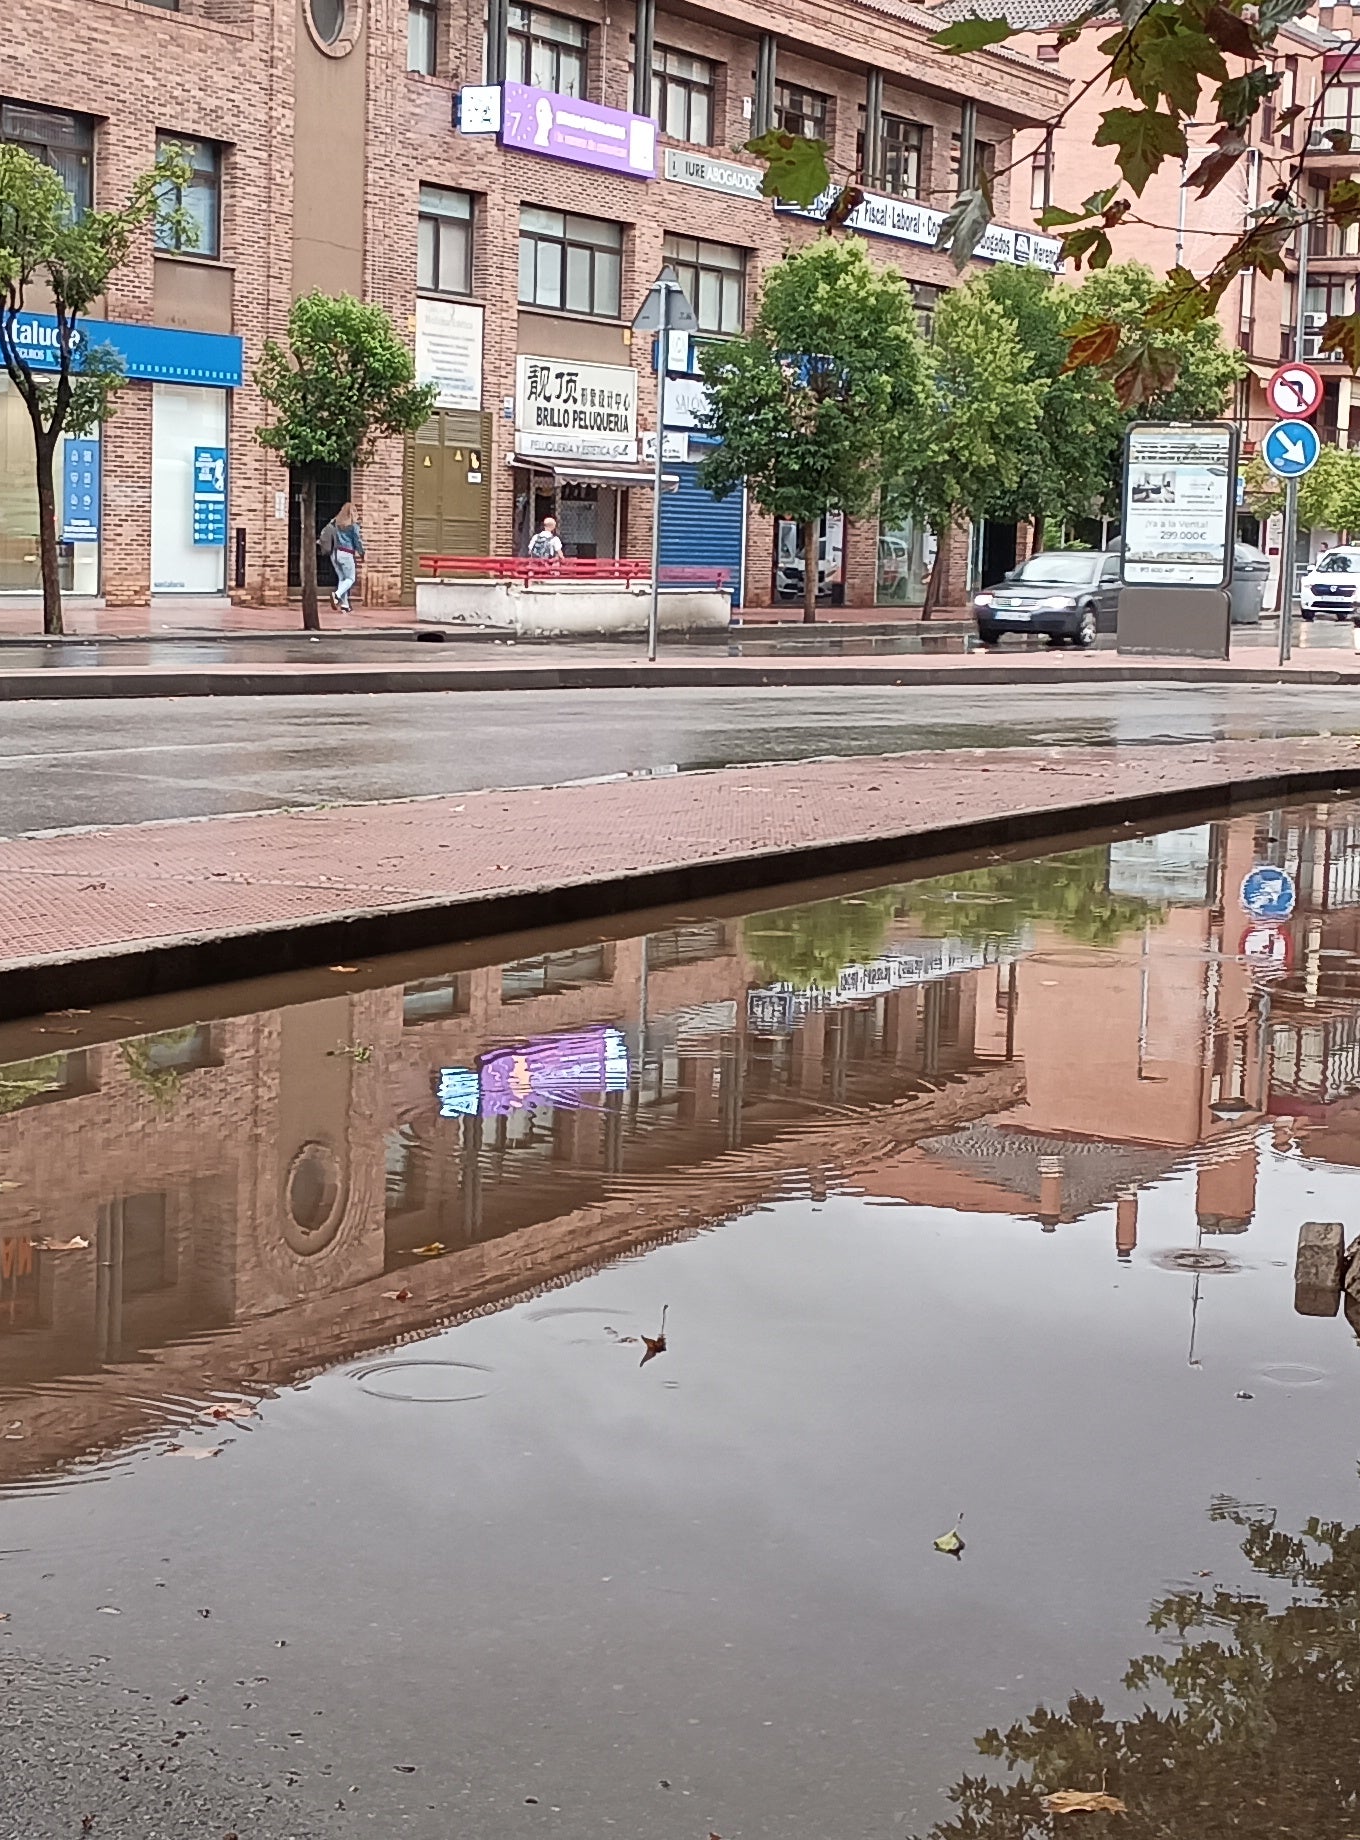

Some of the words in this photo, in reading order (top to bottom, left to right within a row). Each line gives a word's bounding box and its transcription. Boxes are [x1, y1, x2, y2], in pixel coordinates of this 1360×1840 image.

[685, 162, 705, 179] IURE
[706, 167, 756, 191] ABOGADOS
[864, 200, 887, 227] Fiscal
[892, 207, 921, 234] Laboral
[536, 406, 569, 428] BRILLO
[572, 409, 629, 433] PELUQUERIA
